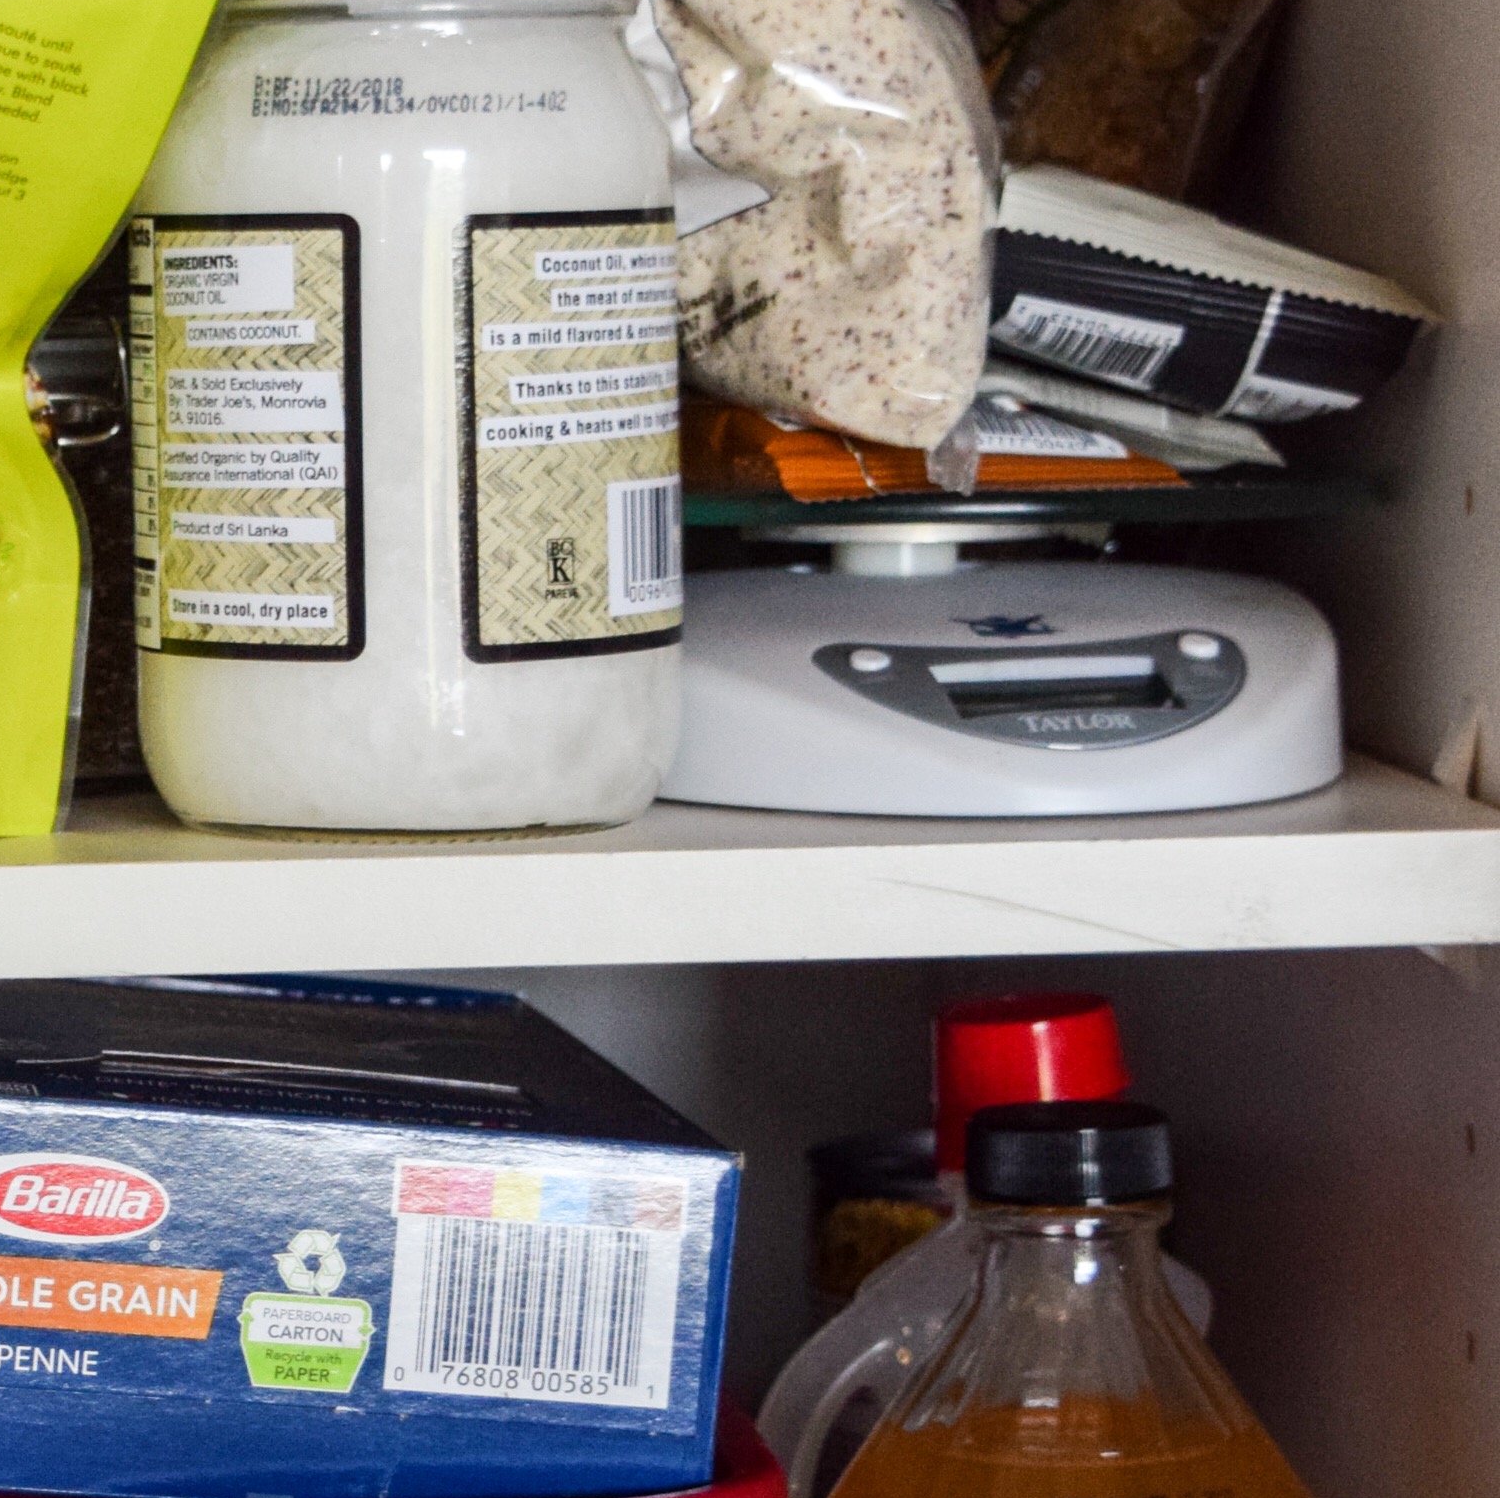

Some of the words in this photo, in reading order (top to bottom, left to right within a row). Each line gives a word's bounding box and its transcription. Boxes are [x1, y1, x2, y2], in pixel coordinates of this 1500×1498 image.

[542, 257, 602, 273] Coconut
[605, 255, 626, 271] Oil,
[188, 328, 237, 341] CONTAINS
[516, 381, 573, 398] Thanks
[578, 378, 591, 394] to
[596, 375, 620, 392] this
[261, 396, 327, 409] Monrovia
[486, 422, 554, 442] cooking
[560, 421, 571, 437] &
[576, 418, 613, 435] heats
[618, 415, 640, 430] well
[214, 468, 294, 482] International
[299, 466, 338, 481] (QAI)
[1017, 713, 1137, 732] TAYLOR
[1, 1175, 153, 1220] Barilla
[68, 1281, 198, 1318] GRAIN
[263, 1308, 351, 1324] PAPERBOARD
[268, 1325, 343, 1342] CARTON
[266, 1349, 311, 1363] Recycle
[316, 1353, 341, 1364] with
[275, 1366, 329, 1382] PAPER
[393, 1367, 405, 1381] 0
[441, 1365, 519, 1389] 76808
[531, 1372, 609, 1396] 00585
[646, 1385, 655, 1399] 1
